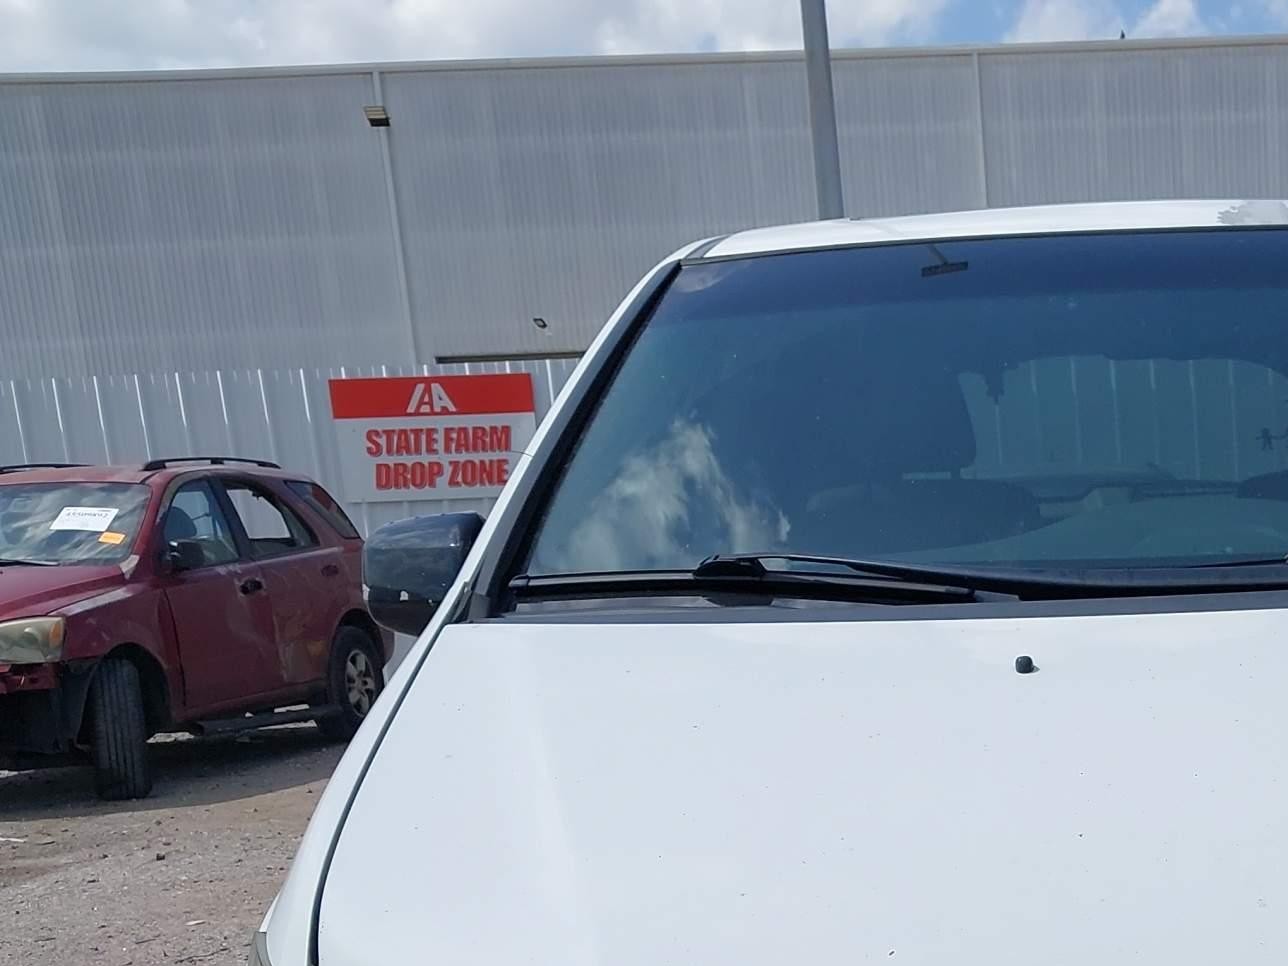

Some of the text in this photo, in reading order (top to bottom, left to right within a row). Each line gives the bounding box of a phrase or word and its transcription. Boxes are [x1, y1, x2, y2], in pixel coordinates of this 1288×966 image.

[366, 425, 512, 458] STATE FARM
[375, 458, 510, 490] DROP ZONE
